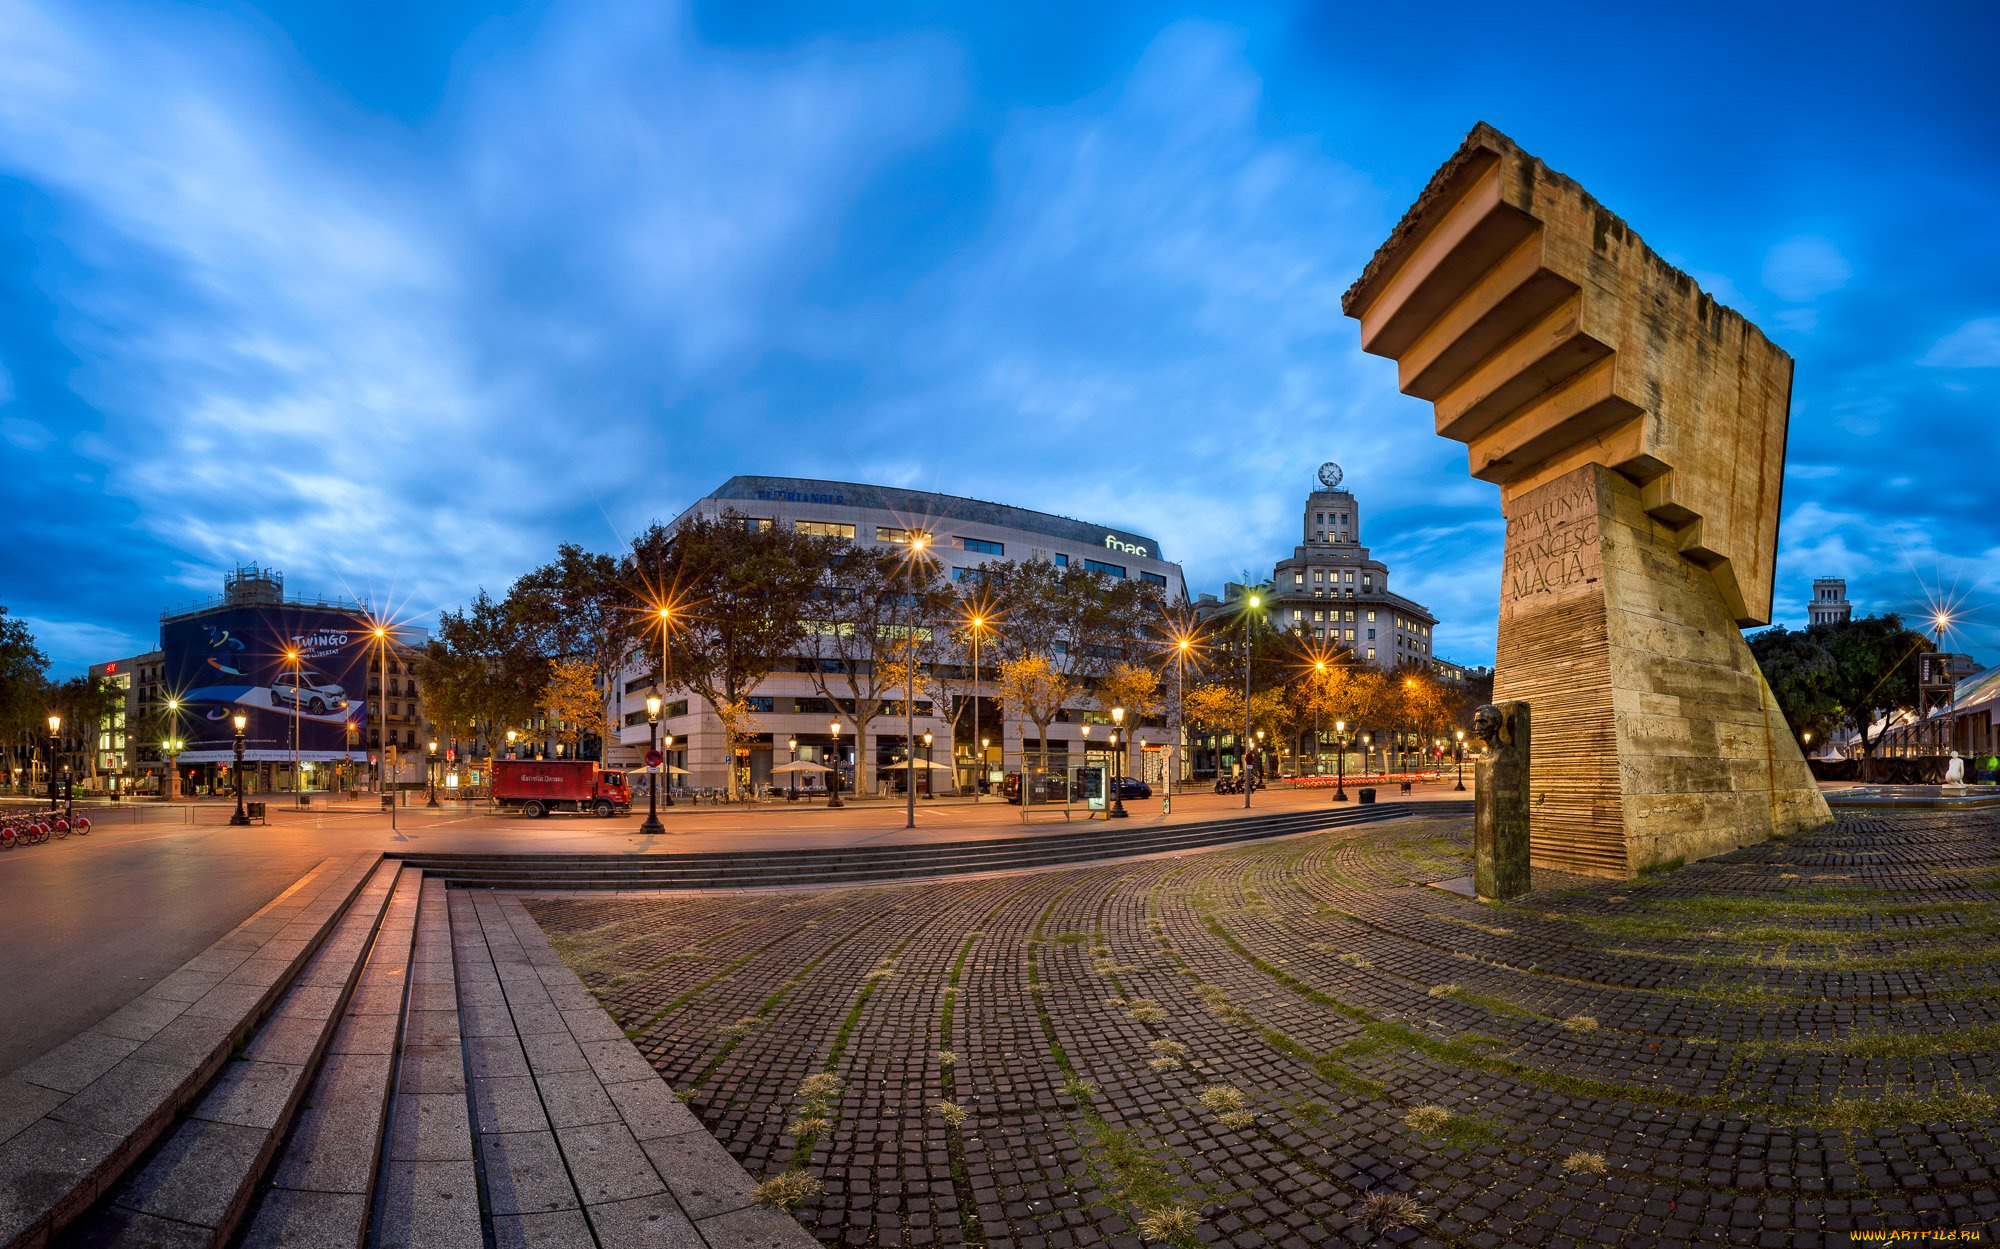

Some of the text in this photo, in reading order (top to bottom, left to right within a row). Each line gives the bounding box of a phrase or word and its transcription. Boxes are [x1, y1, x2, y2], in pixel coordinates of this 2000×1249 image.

[1506, 486, 1593, 538] CATALUNYA
[1541, 522, 1552, 540] A
[1105, 534, 1147, 557] fnac
[1505, 522, 1598, 576] FRANCESC
[520, 774, 544, 782] Estrella
